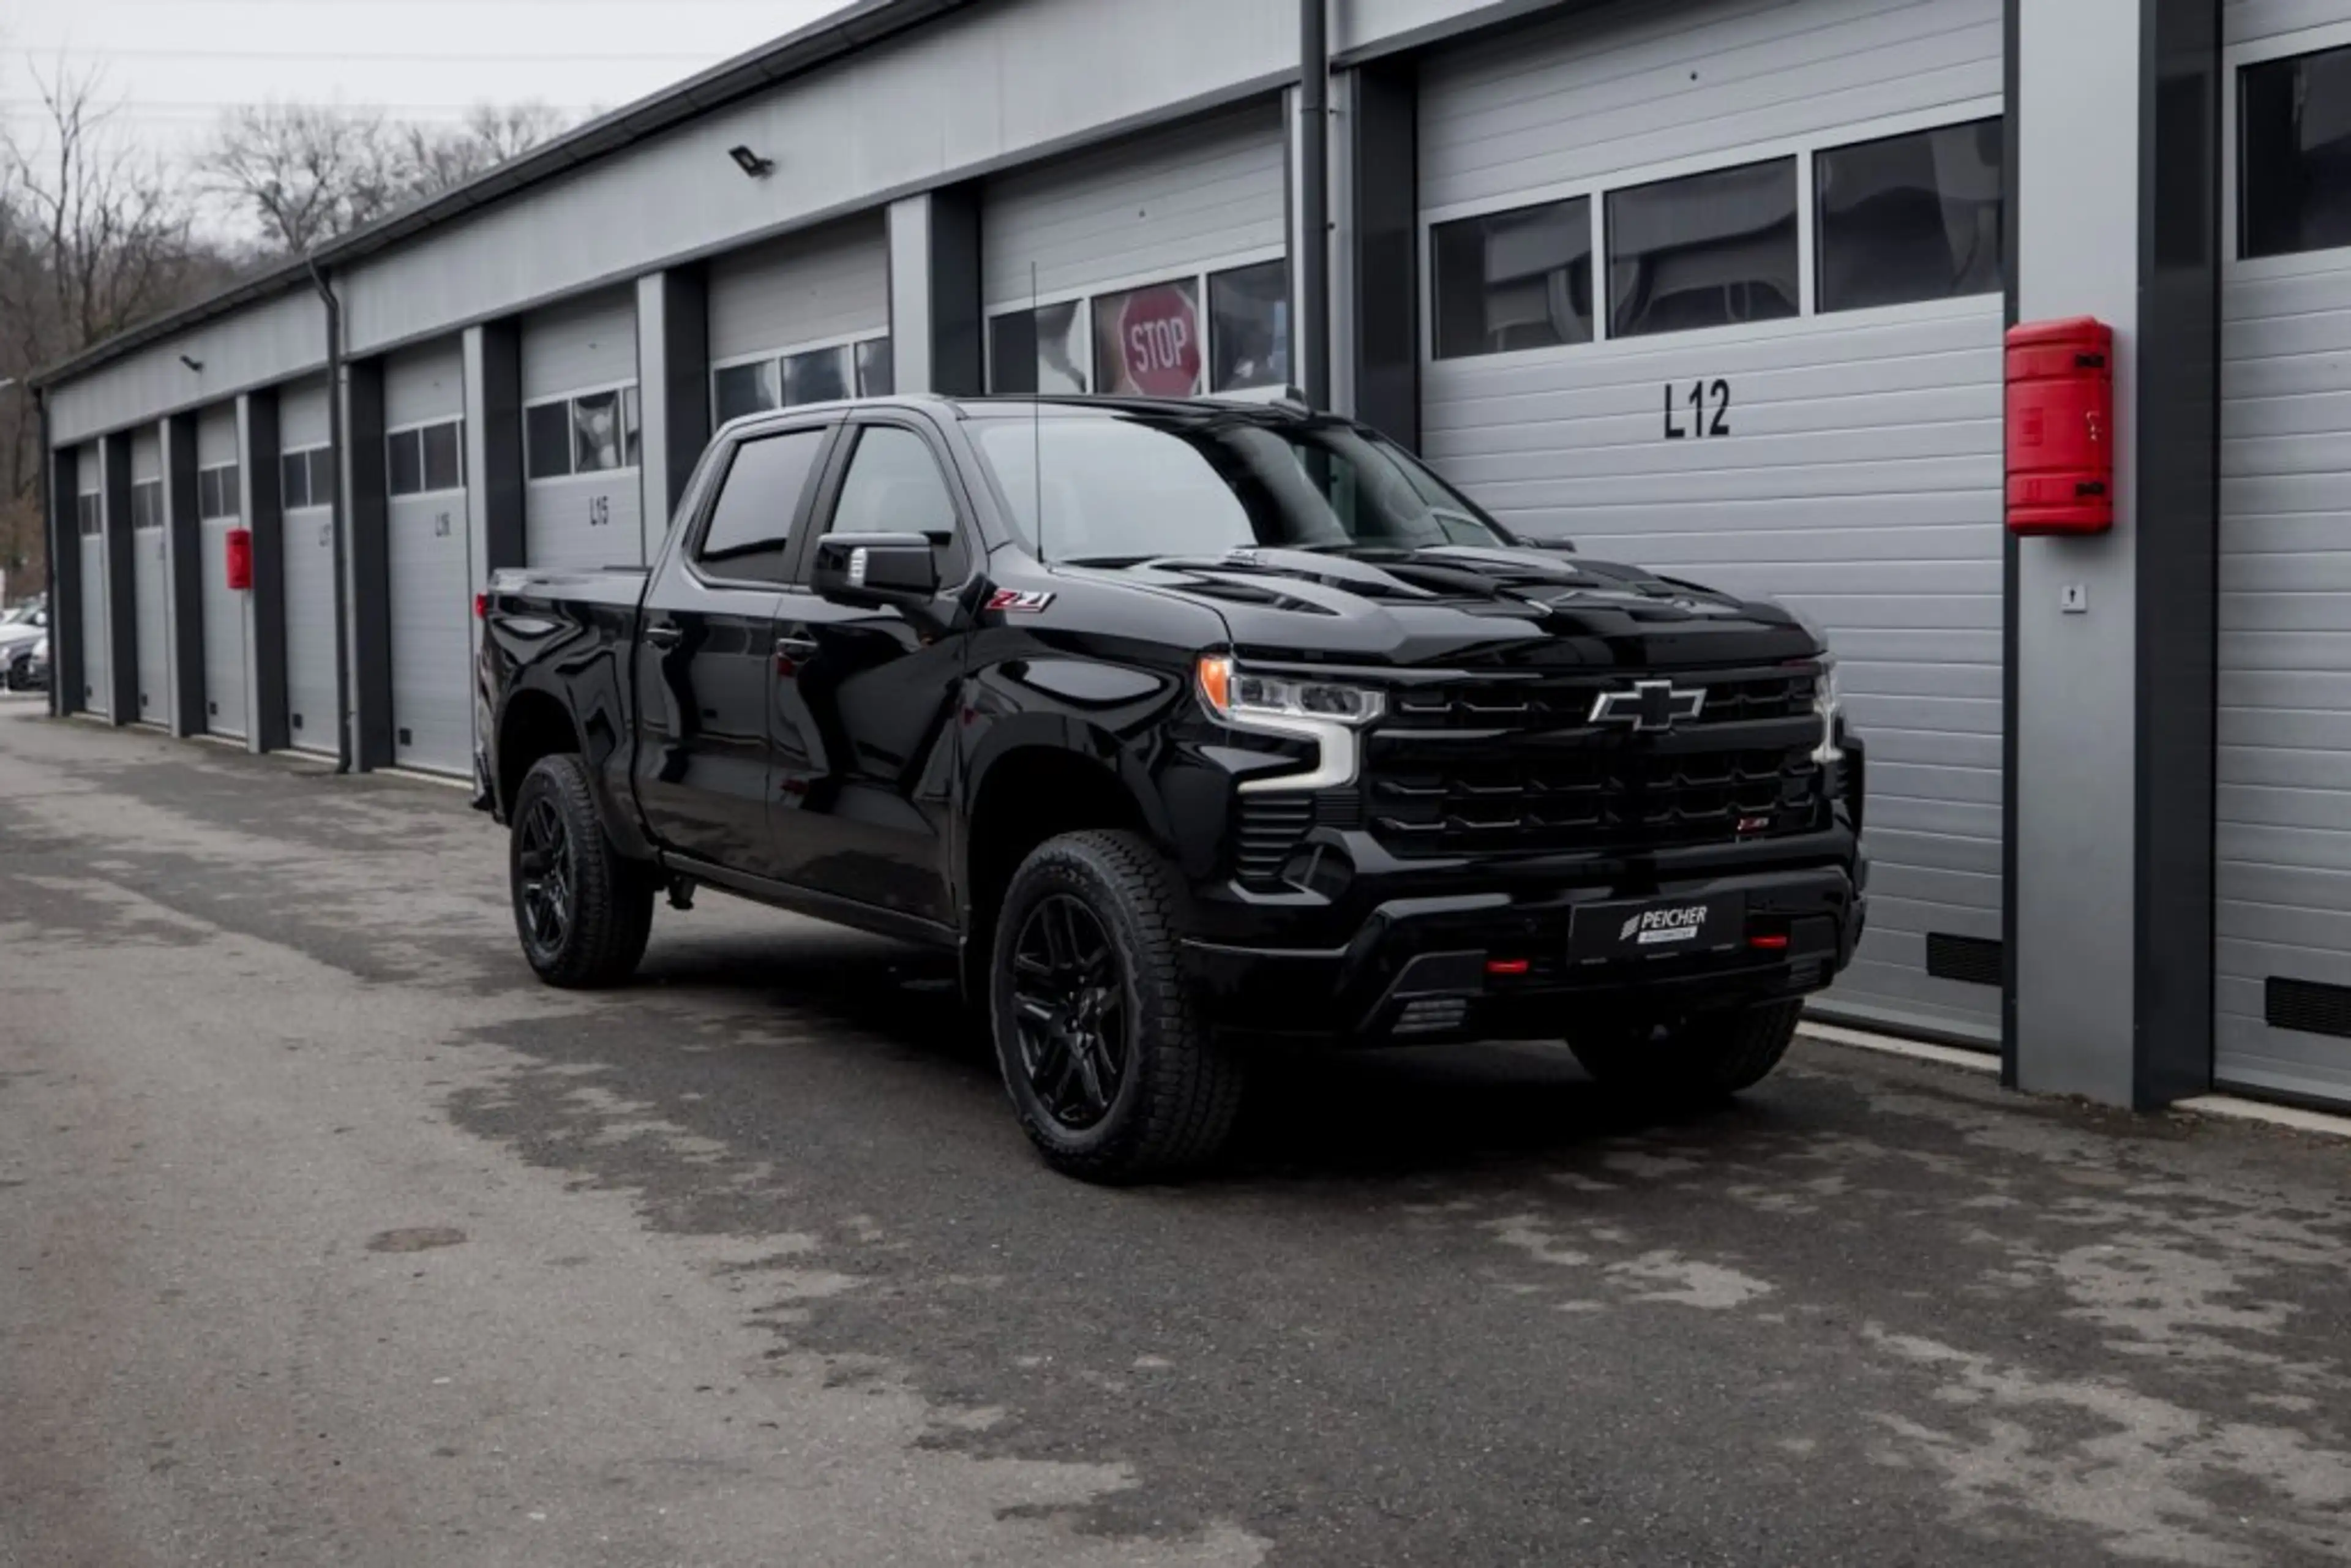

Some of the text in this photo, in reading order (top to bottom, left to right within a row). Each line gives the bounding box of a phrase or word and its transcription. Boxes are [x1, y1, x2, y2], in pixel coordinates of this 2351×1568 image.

[1131, 317, 1186, 373] STOP
[1665, 378, 1730, 439] L12
[590, 495, 609, 526] L15
[1641, 906, 1708, 929] PEICHER
